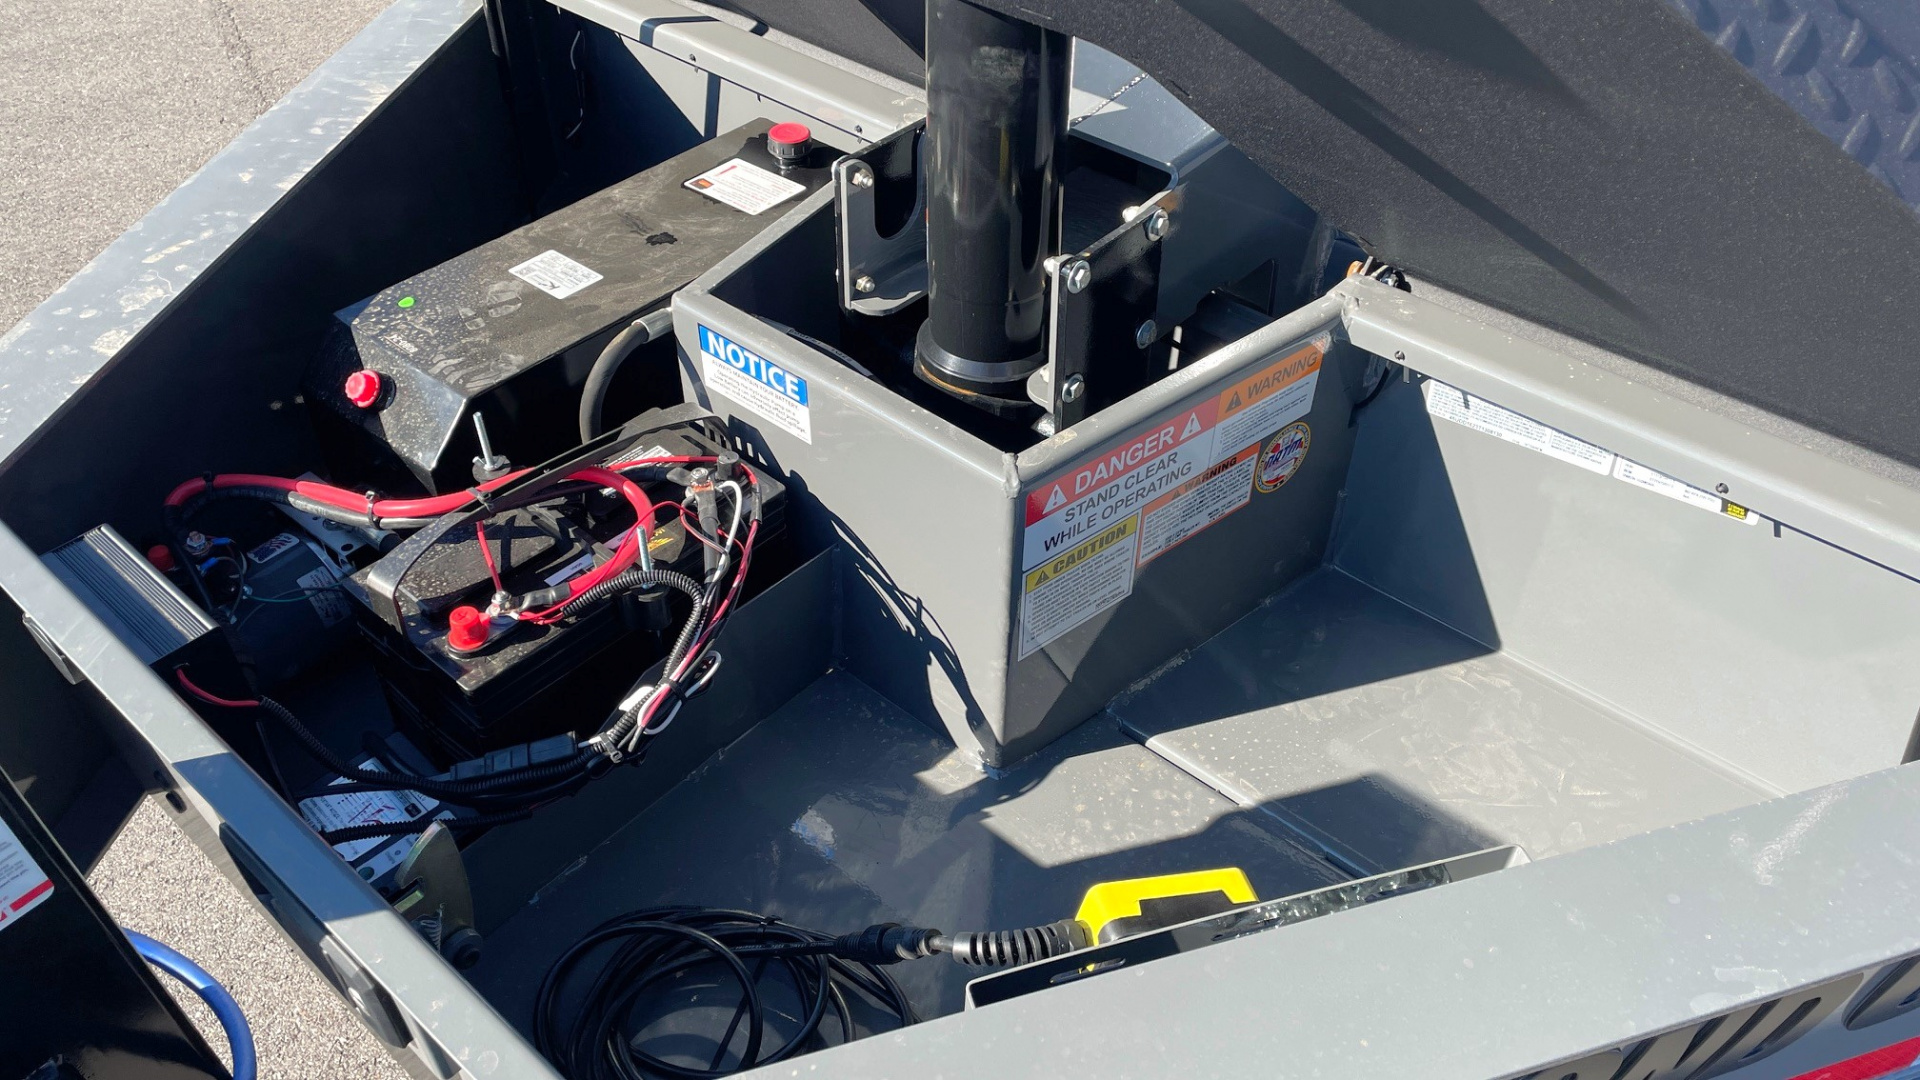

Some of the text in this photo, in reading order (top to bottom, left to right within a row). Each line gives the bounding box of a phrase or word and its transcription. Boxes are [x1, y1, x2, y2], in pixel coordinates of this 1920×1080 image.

[707, 331, 800, 401] NOTICE
[1247, 351, 1318, 399] WARNING
[1064, 484, 1119, 523] STAND
[1124, 452, 1178, 490] CLEAR
[1075, 426, 1175, 495] DANGER
[1184, 457, 1237, 493] WARNING
[1044, 513, 1097, 552] WHILE
[1101, 461, 1193, 521] OPERATING
[1053, 524, 1128, 574] CAUTION
